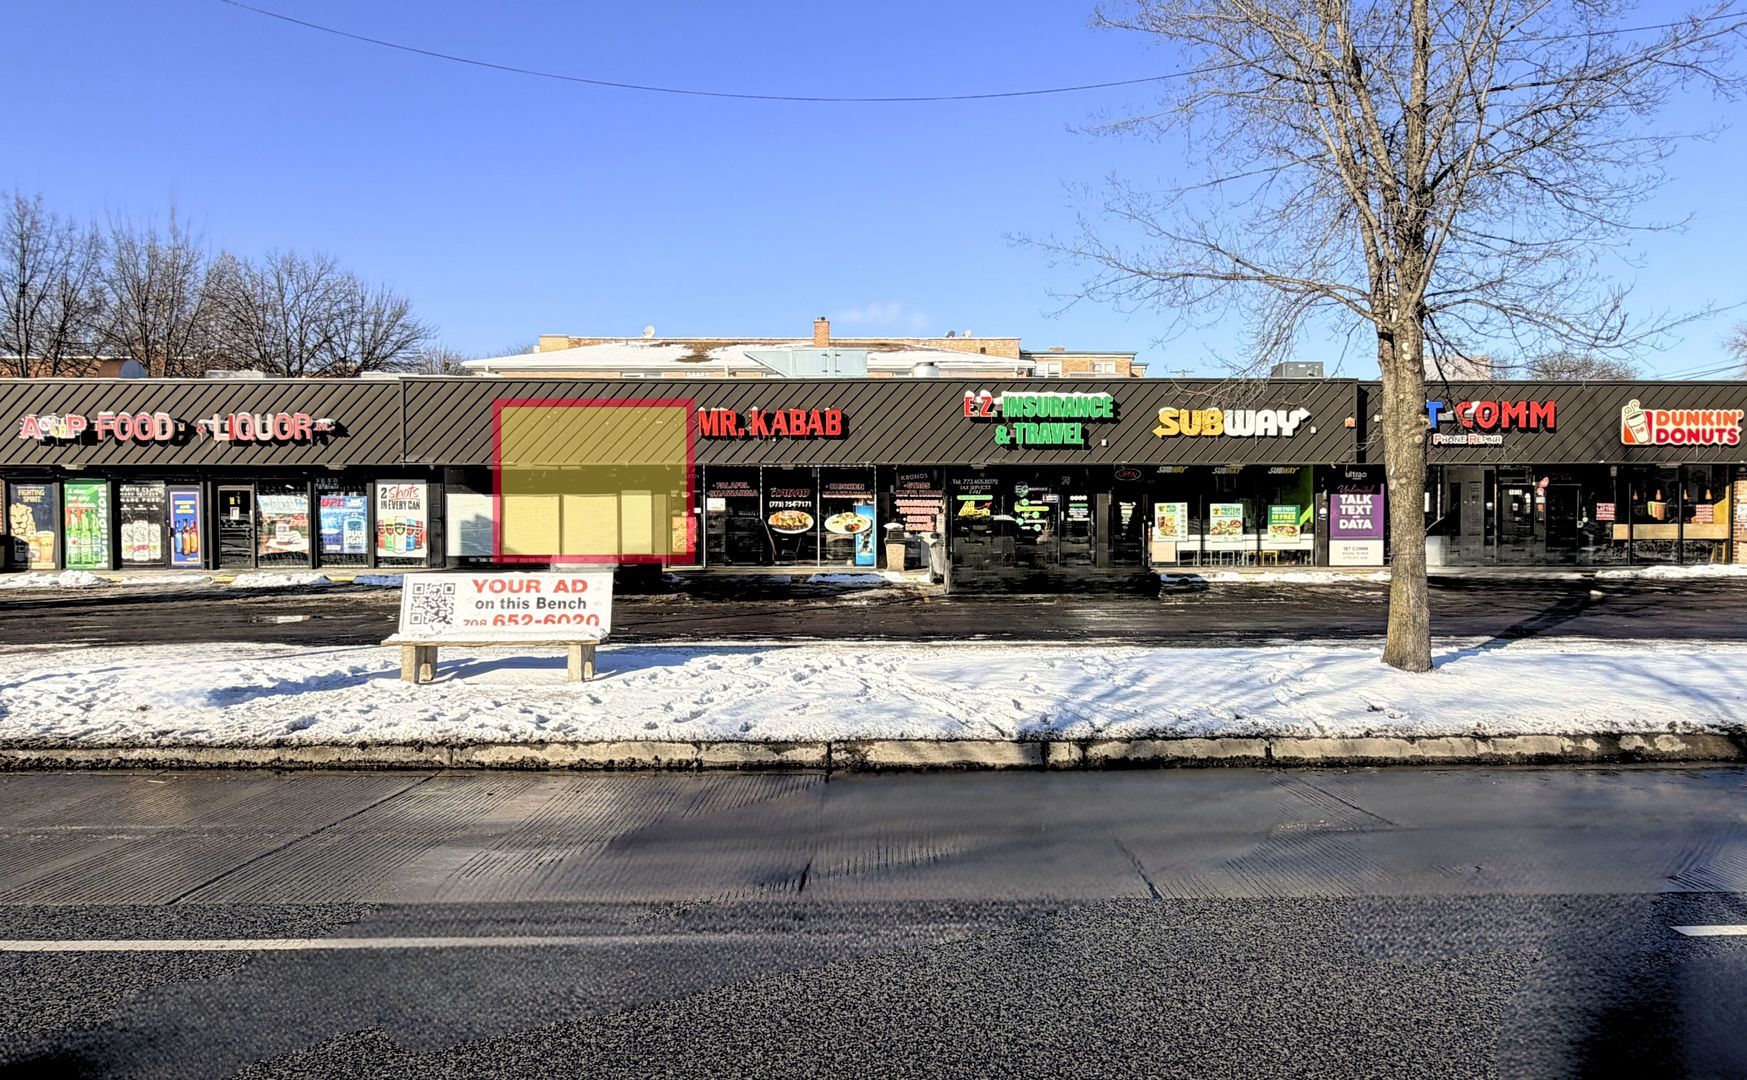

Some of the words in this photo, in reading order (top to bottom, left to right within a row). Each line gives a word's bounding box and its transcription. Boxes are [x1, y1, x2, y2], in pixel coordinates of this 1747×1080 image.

[1002, 395, 1114, 418] INSURANCE
[1456, 400, 1556, 429] COMM
[97, 411, 174, 441] FOOD
[213, 411, 312, 441] LIQUOR
[698, 407, 745, 436] MR.
[751, 407, 842, 436] KABAB
[1152, 406, 1311, 437] SUBWAY
[1656, 410, 1743, 427] DUNKIN'
[994, 425, 1010, 445] &
[1013, 422, 1084, 444] TRAVEL
[1656, 427, 1738, 444] DONUTS
[381, 487, 387, 499] 2
[388, 483, 420, 498] Shots
[1340, 494, 1372, 504] TALK
[388, 501, 406, 510] EVERY
[407, 501, 420, 510] CAN
[1340, 505, 1372, 515] TEXT
[1339, 519, 1373, 529] DATA
[472, 579, 541, 593] YOUR
[553, 579, 588, 593] AD
[475, 600, 494, 609] on
[500, 597, 530, 609] this
[536, 597, 587, 609] Bench
